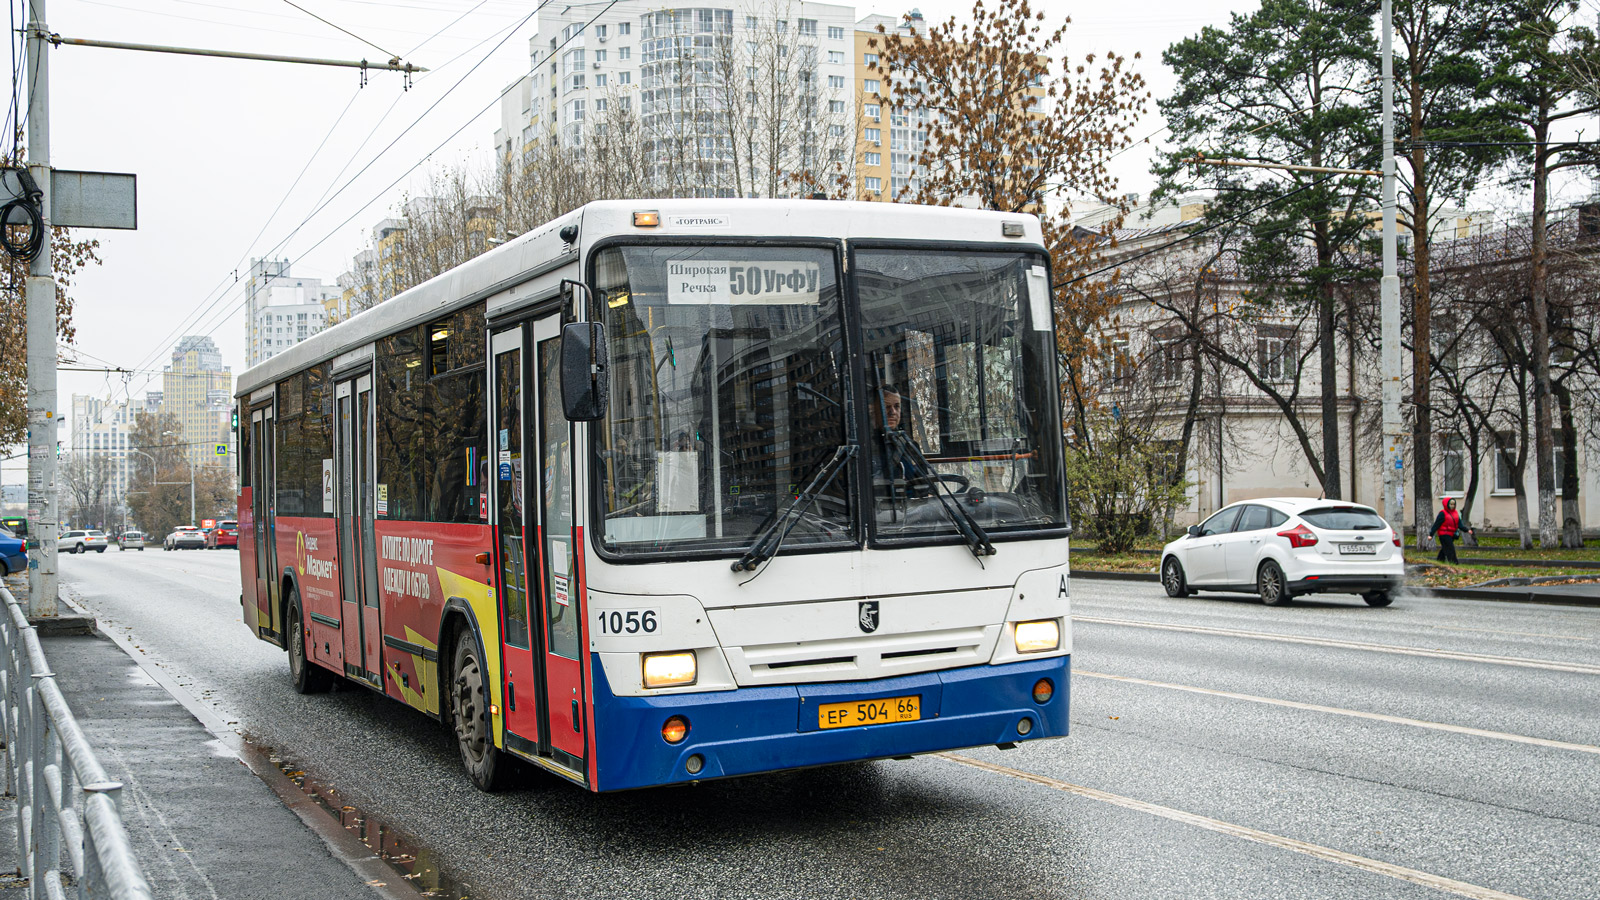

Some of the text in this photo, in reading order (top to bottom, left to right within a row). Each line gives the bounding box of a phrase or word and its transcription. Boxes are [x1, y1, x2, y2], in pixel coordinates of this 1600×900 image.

[670, 264, 727, 278] Широкая
[729, 266, 819, 296] 50 УрФУ
[681, 282, 717, 294] Речка
[381, 535, 434, 567] КУПИТЕ ПО ДОРОГЕ
[306, 554, 333, 581] Маркет
[383, 566, 430, 600] ОДЕЖДУ И ОБУВЬ
[598, 610, 658, 635] 1056
[857, 702, 888, 721] 504
[897, 699, 914, 713] 66
